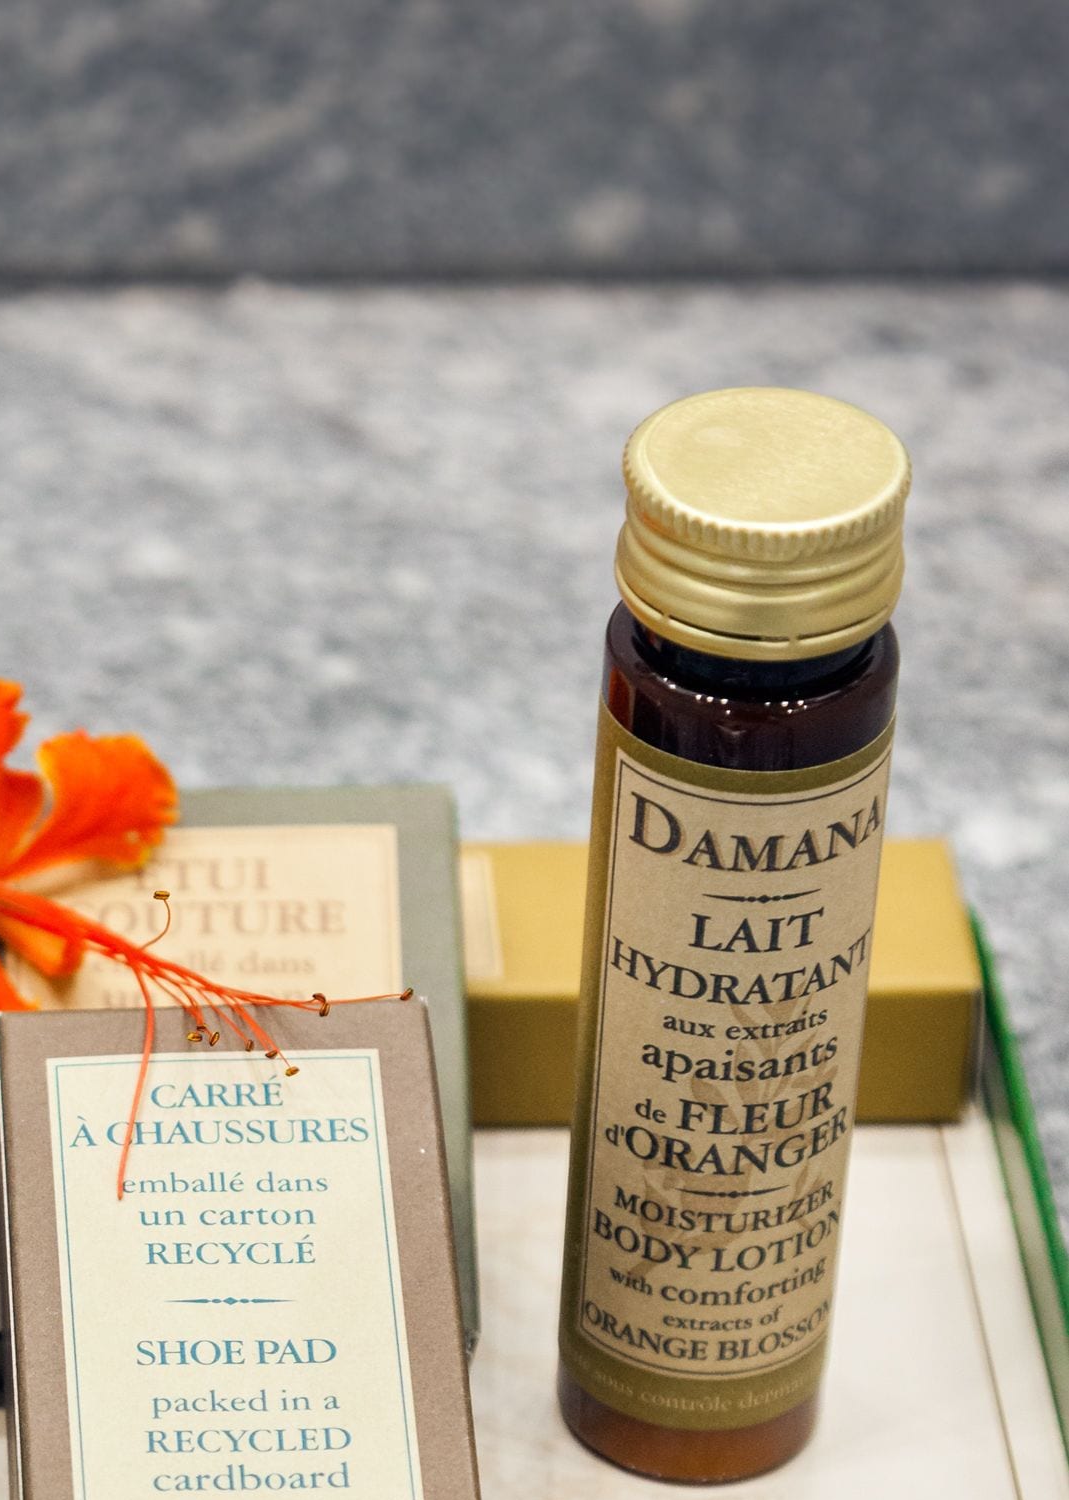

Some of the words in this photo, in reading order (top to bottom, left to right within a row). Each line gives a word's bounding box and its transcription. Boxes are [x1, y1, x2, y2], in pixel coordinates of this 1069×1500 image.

[628, 791, 882, 873] DAMANA
[72, 897, 347, 936] OUTURE
[688, 906, 825, 954] LAIT
[235, 950, 317, 975] dans
[610, 928, 872, 1006] HYDRATANT
[662, 1012, 716, 1039] aux
[725, 1008, 829, 1041] extraits
[642, 1036, 838, 1083] apaisants
[149, 1075, 284, 1109] CARRÉ
[635, 1098, 668, 1125] de
[676, 1081, 835, 1136] FLEUR
[69, 1116, 98, 1149] À
[106, 1116, 371, 1148] CHAUSSURES
[604, 1105, 849, 1176] d'ORANGER
[121, 1171, 245, 1196] emballé
[255, 1171, 330, 1194] dans
[138, 1209, 186, 1227] un
[199, 1206, 317, 1227] carton
[614, 1180, 836, 1235] MOISTURIZER
[145, 1234, 317, 1266] RECYCLÉ
[593, 1209, 702, 1271] BODY
[610, 1266, 654, 1296] with
[660, 1256, 827, 1307] comforting
[584, 1300, 709, 1361] ORANGE
[662, 1312, 753, 1332] extracts
[759, 1305, 784, 1327] of
[136, 1339, 246, 1367] SHOE
[254, 1338, 338, 1366] PAD
[151, 1389, 270, 1420] packed
[279, 1389, 310, 1413] in
[323, 1394, 342, 1412] a
[145, 1426, 352, 1455] RECYCLED
[152, 1462, 352, 1493] cardboard
